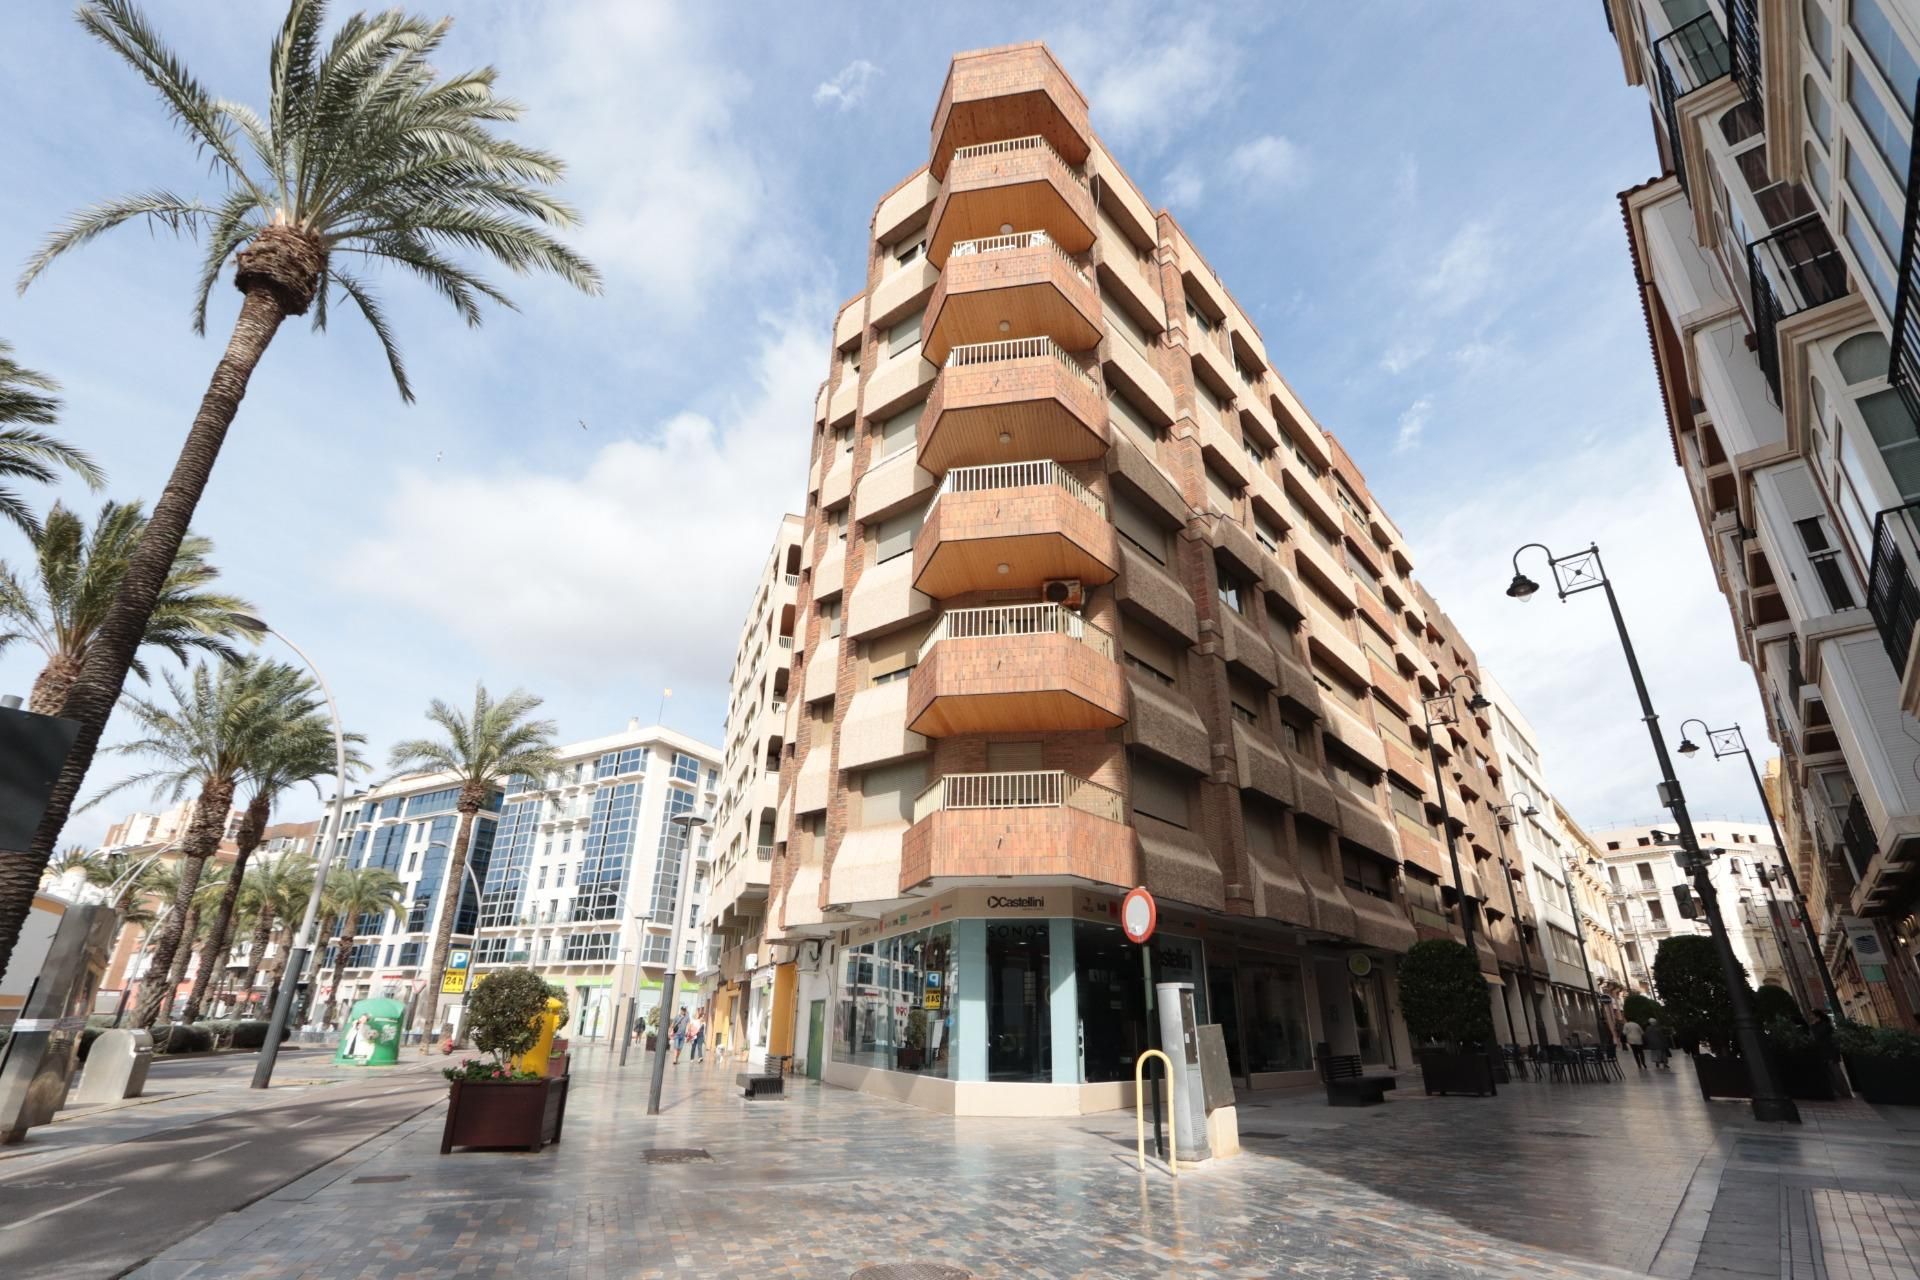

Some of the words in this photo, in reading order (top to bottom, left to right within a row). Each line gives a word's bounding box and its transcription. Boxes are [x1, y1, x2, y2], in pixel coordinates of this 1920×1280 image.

[998, 895, 1045, 908] Castellini
[452, 953, 466, 967] P
[445, 976, 457, 985] 24
[457, 976, 464, 986] h
